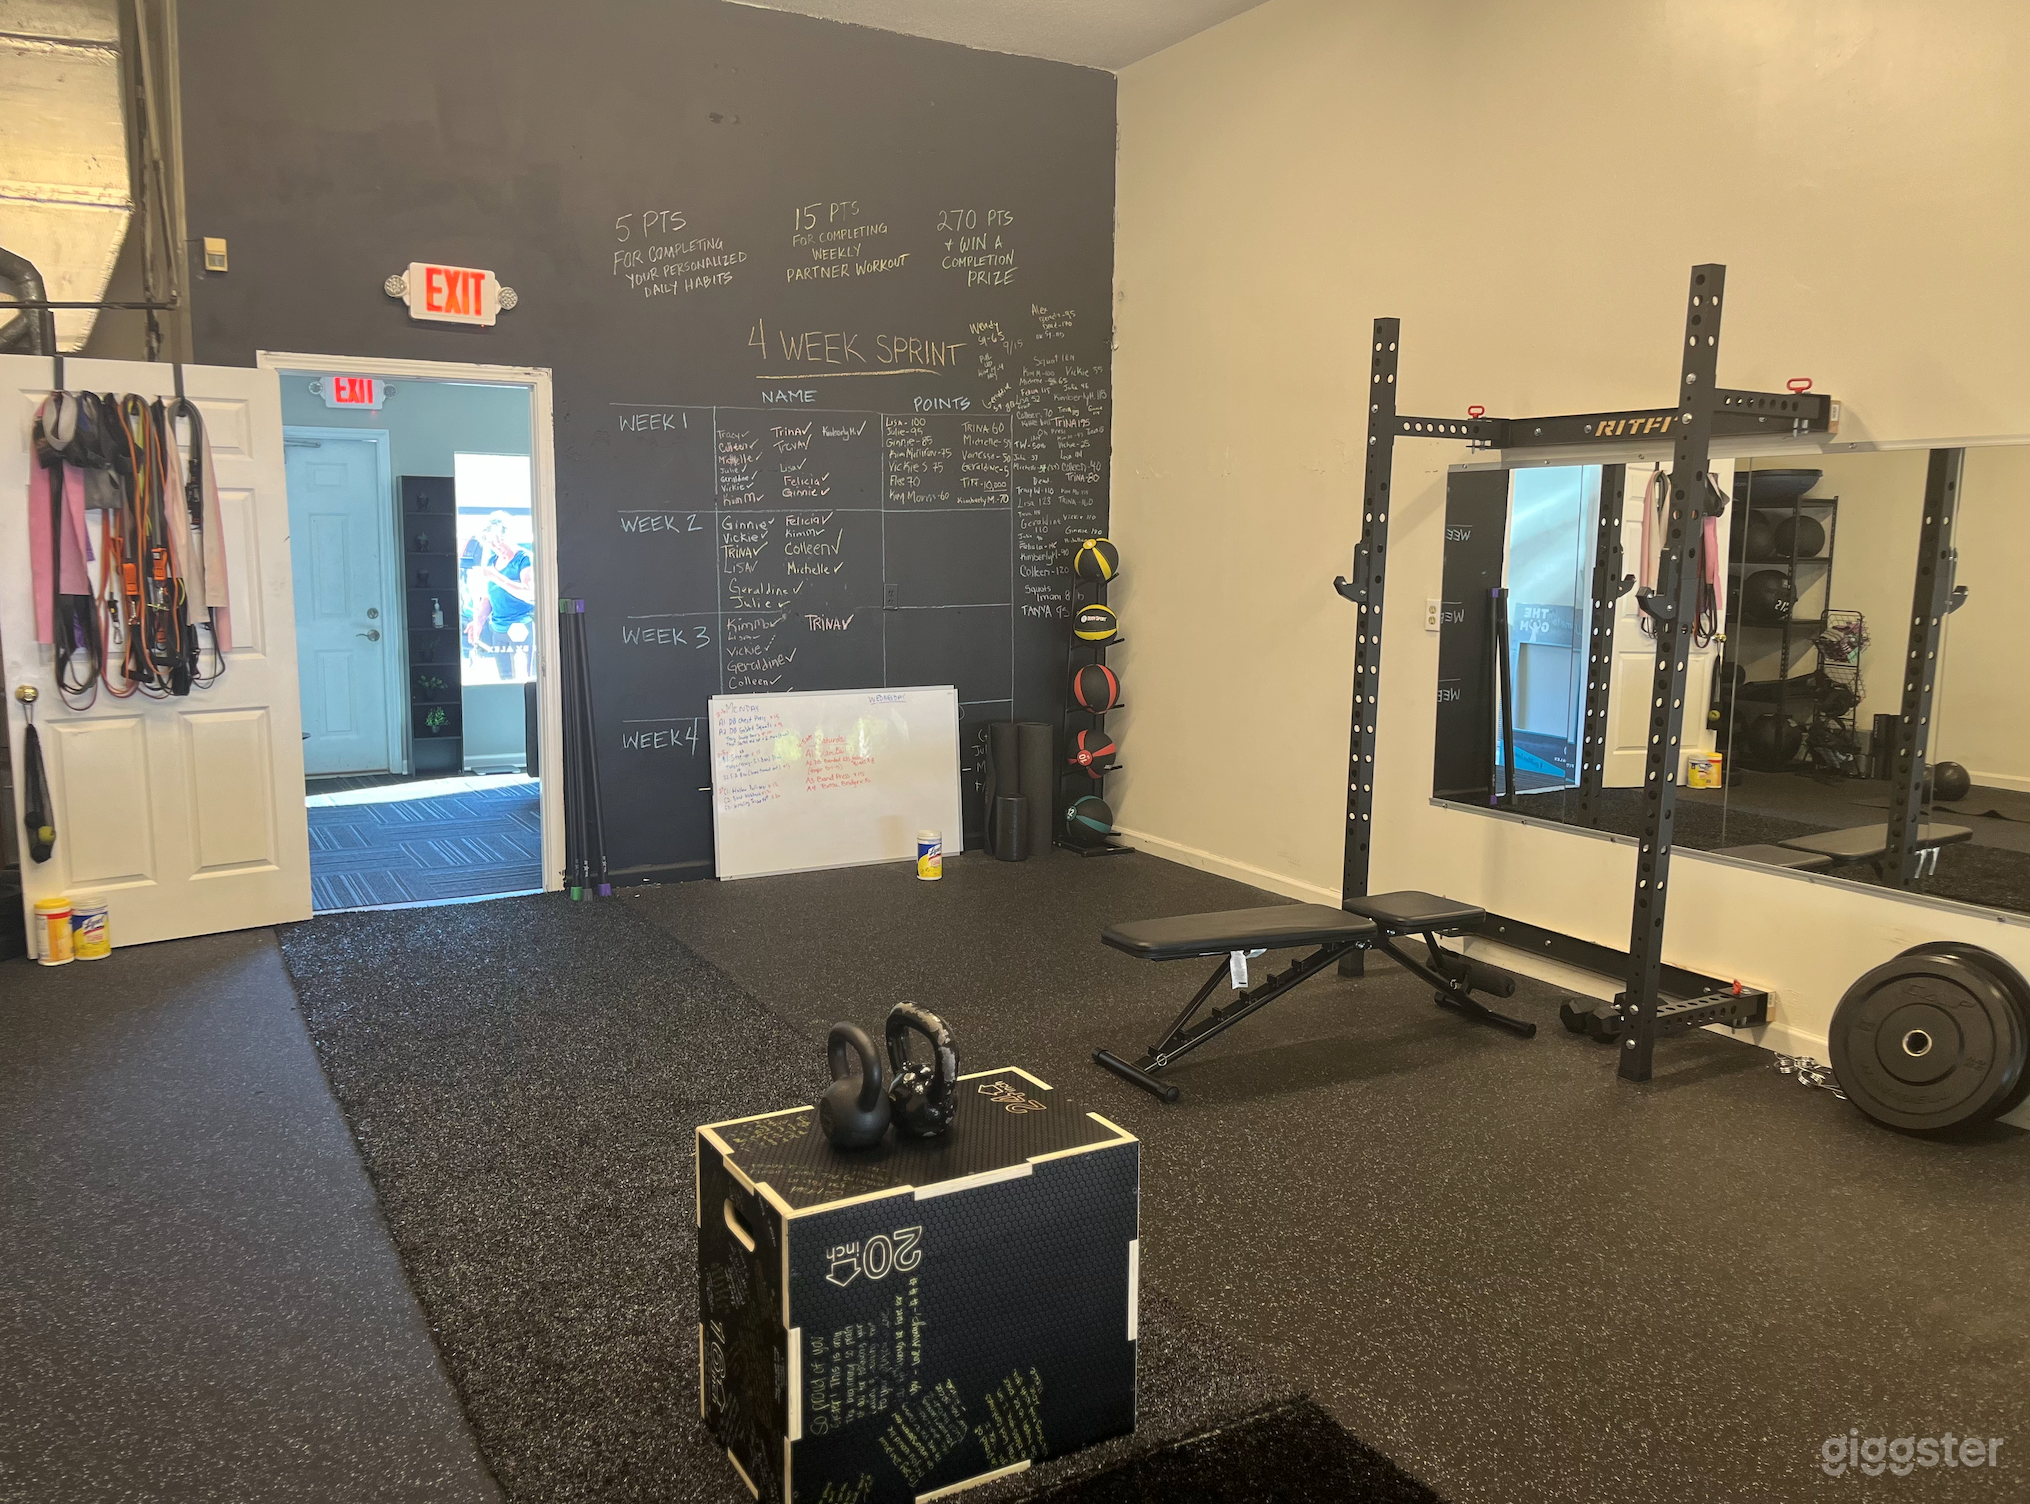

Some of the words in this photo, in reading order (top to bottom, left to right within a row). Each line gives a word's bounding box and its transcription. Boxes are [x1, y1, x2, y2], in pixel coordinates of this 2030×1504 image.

[795, 202, 823, 231] 15
[829, 200, 860, 223] PTS
[936, 209, 977, 232] 270
[987, 209, 1014, 227] PTS
[616, 213, 633, 242] 5
[643, 210, 687, 237] PTS
[792, 234, 815, 247] FOR
[819, 222, 888, 244] COMPLETING
[812, 243, 862, 261] WEEKLY
[959, 233, 987, 253] WIN
[995, 235, 1003, 250] A
[613, 250, 643, 275] FOR
[648, 238, 724, 263] COMPLETING
[942, 249, 1015, 270] COMPLETION
[625, 267, 659, 289] YOUR
[663, 252, 747, 278] PERSONALIZED
[786, 264, 850, 283] PARTNER
[855, 253, 911, 276] WORKOUT
[967, 266, 1019, 288] PRIZE
[425, 267, 486, 316] EXIT
[644, 281, 678, 298] DAILY
[684, 271, 733, 292] HABITS
[748, 318, 767, 360] 4
[780, 330, 867, 365] WEEK
[876, 334, 968, 366] SPRINT
[334, 376, 374, 404] EXIT
[762, 389, 818, 404] NAME
[913, 396, 971, 413] POINTS
[1043, 408, 1053, 417] 70
[618, 413, 676, 432] WEEK
[682, 412, 688, 430] 1
[911, 418, 926, 427] 100
[992, 422, 1005, 434] 60
[1595, 416, 1678, 437] RITFI
[889, 461, 919, 473] Vickie
[932, 461, 944, 473] 75
[721, 483, 745, 492] Vickie
[783, 473, 820, 486] Felicia
[906, 476, 921, 487] 70
[782, 486, 818, 498] Ginnie
[1017, 498, 1035, 508] Lisa
[1039, 496, 1051, 506] 123
[620, 514, 680, 533] WEEK
[686, 513, 703, 533] 2
[721, 515, 767, 530] Ginnie
[785, 513, 820, 526] Felicia
[723, 533, 758, 544] Vickie
[784, 541, 831, 556] Colleen
[787, 561, 830, 575] Michelle
[729, 577, 789, 596] Geraldine
[729, 596, 772, 609] Julie
[1021, 604, 1052, 618] TANYA
[622, 625, 688, 645] WEEK
[693, 625, 710, 649] 3
[726, 643, 762, 657] Vickie
[727, 654, 785, 674] Geraldine
[728, 676, 769, 690] Colleen
[725, 702, 760, 714] MONDAY
[868, 694, 906, 703] WEDNESDAY
[622, 728, 683, 750] WEEK
[685, 717, 699, 756] 4
[826, 1242, 860, 1262] inch
[863, 1226, 922, 1280] 20
[811, 1377, 830, 1411] proud
[810, 1415, 829, 1435] So
